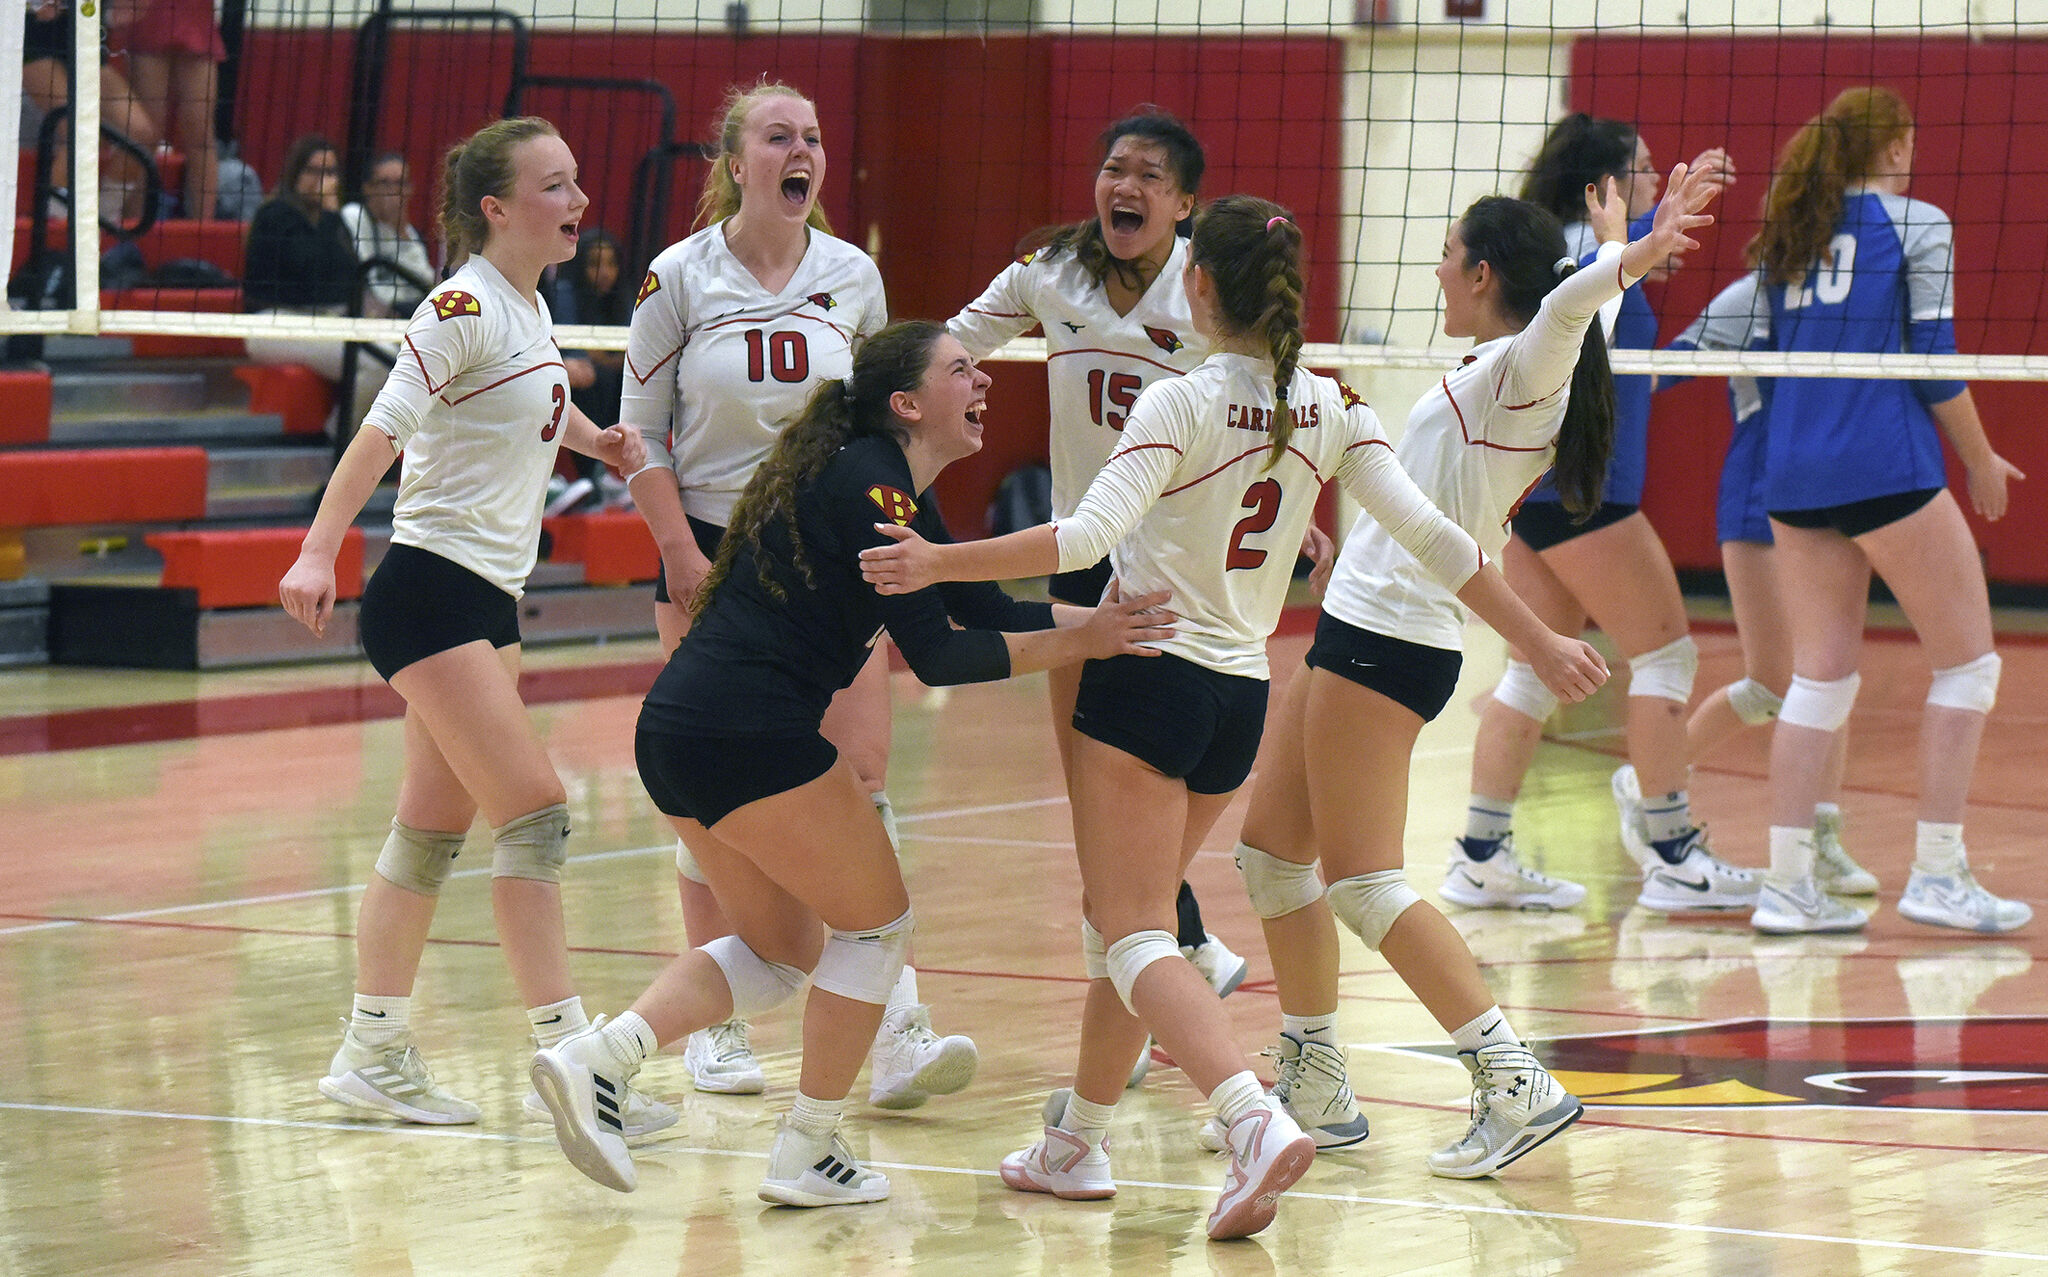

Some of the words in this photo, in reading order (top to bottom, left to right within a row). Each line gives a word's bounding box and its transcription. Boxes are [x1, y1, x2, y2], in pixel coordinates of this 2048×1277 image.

[745, 329, 809, 383] 10
[541, 384, 566, 442] 3
[1088, 369, 1142, 431] 15
[1227, 404, 1319, 432] CARALS
[1226, 477, 1282, 572] 2
